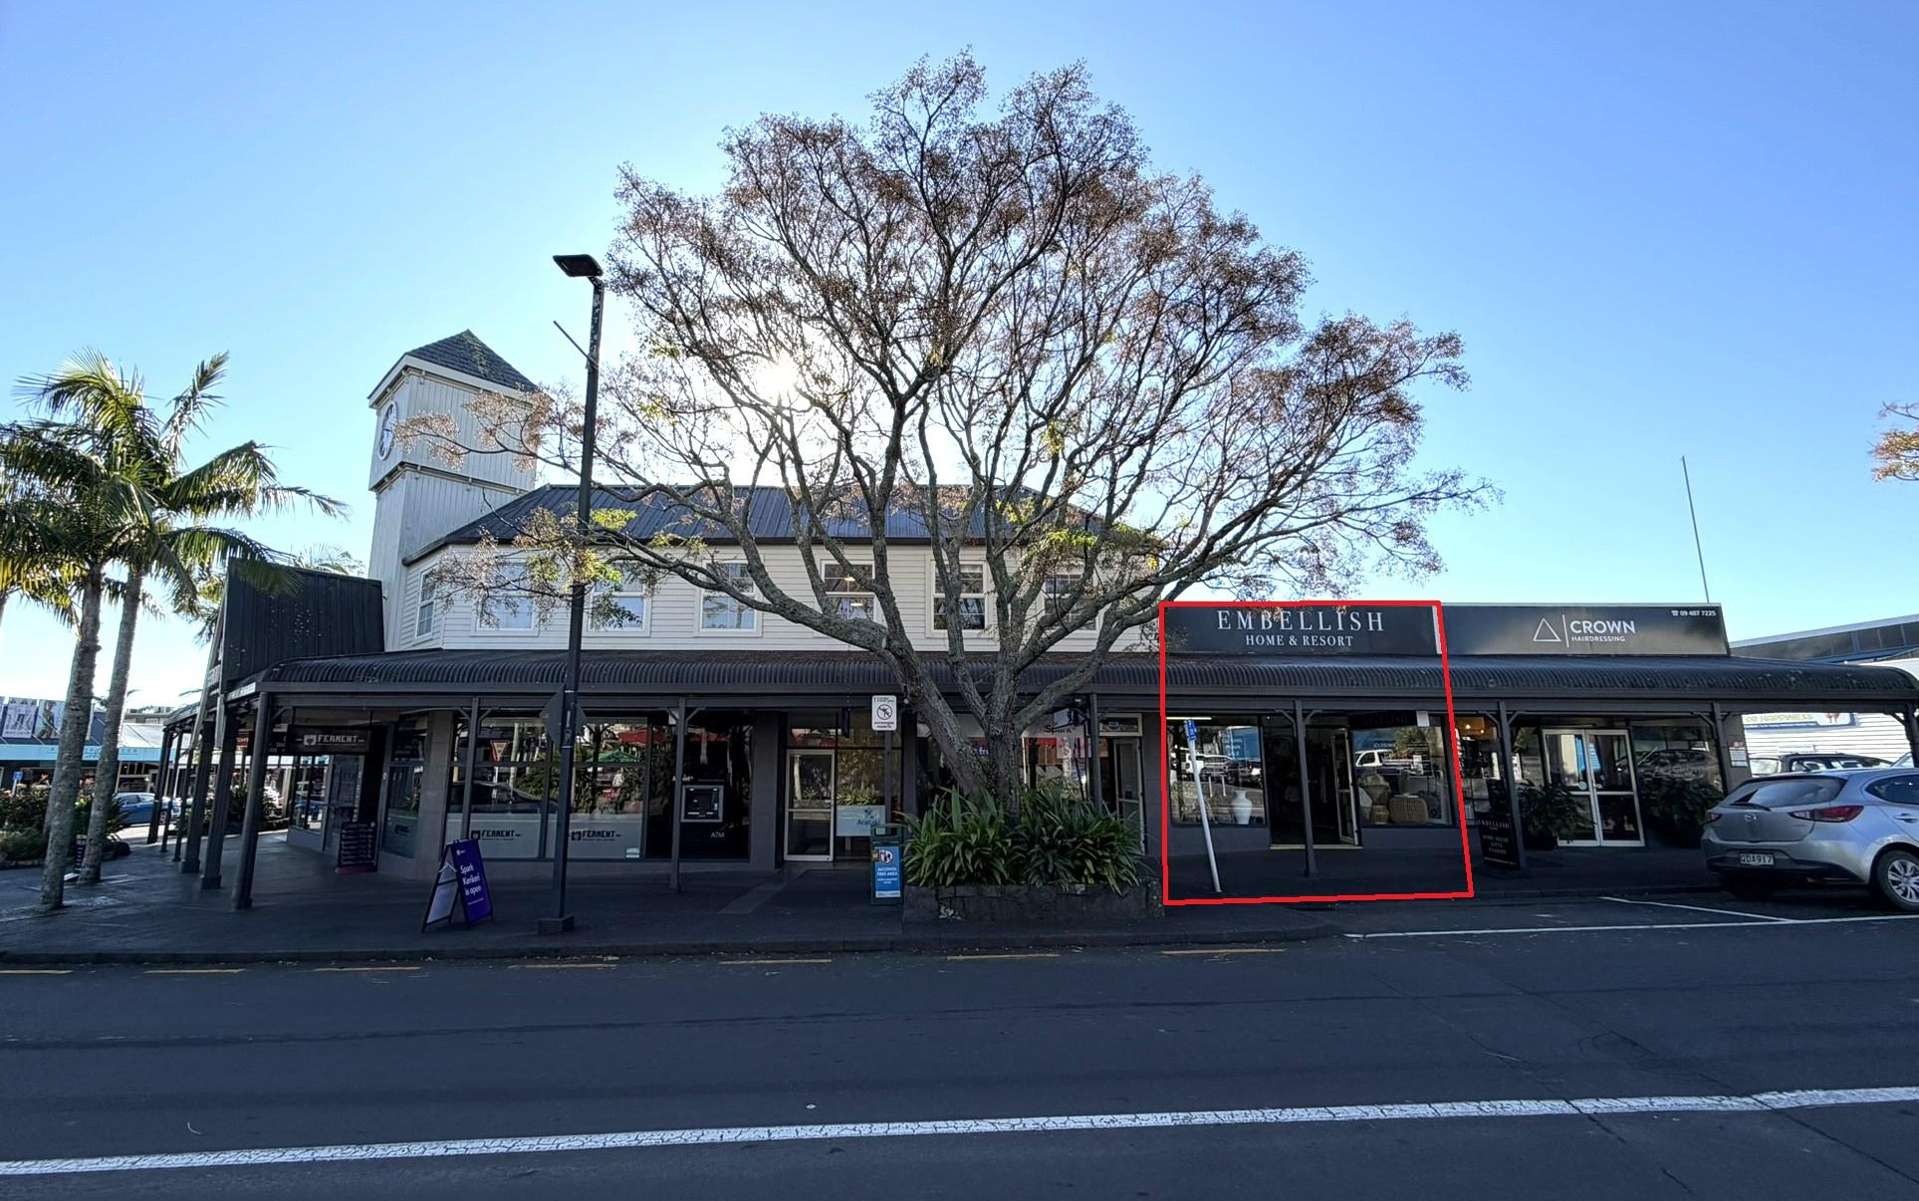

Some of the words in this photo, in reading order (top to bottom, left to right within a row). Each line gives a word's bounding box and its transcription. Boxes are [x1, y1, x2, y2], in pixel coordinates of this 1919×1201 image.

[1217, 609, 1385, 631] EMBELLISH
[1570, 620, 1636, 634] CROWN
[1245, 634, 1286, 646] HOME
[1288, 635, 1298, 646] &
[1302, 635, 1354, 647] RESORT
[317, 734, 358, 743] FERMENT
[709, 831, 726, 839] ATM
[460, 863, 474, 875] Spark
[470, 885, 482, 896] open
